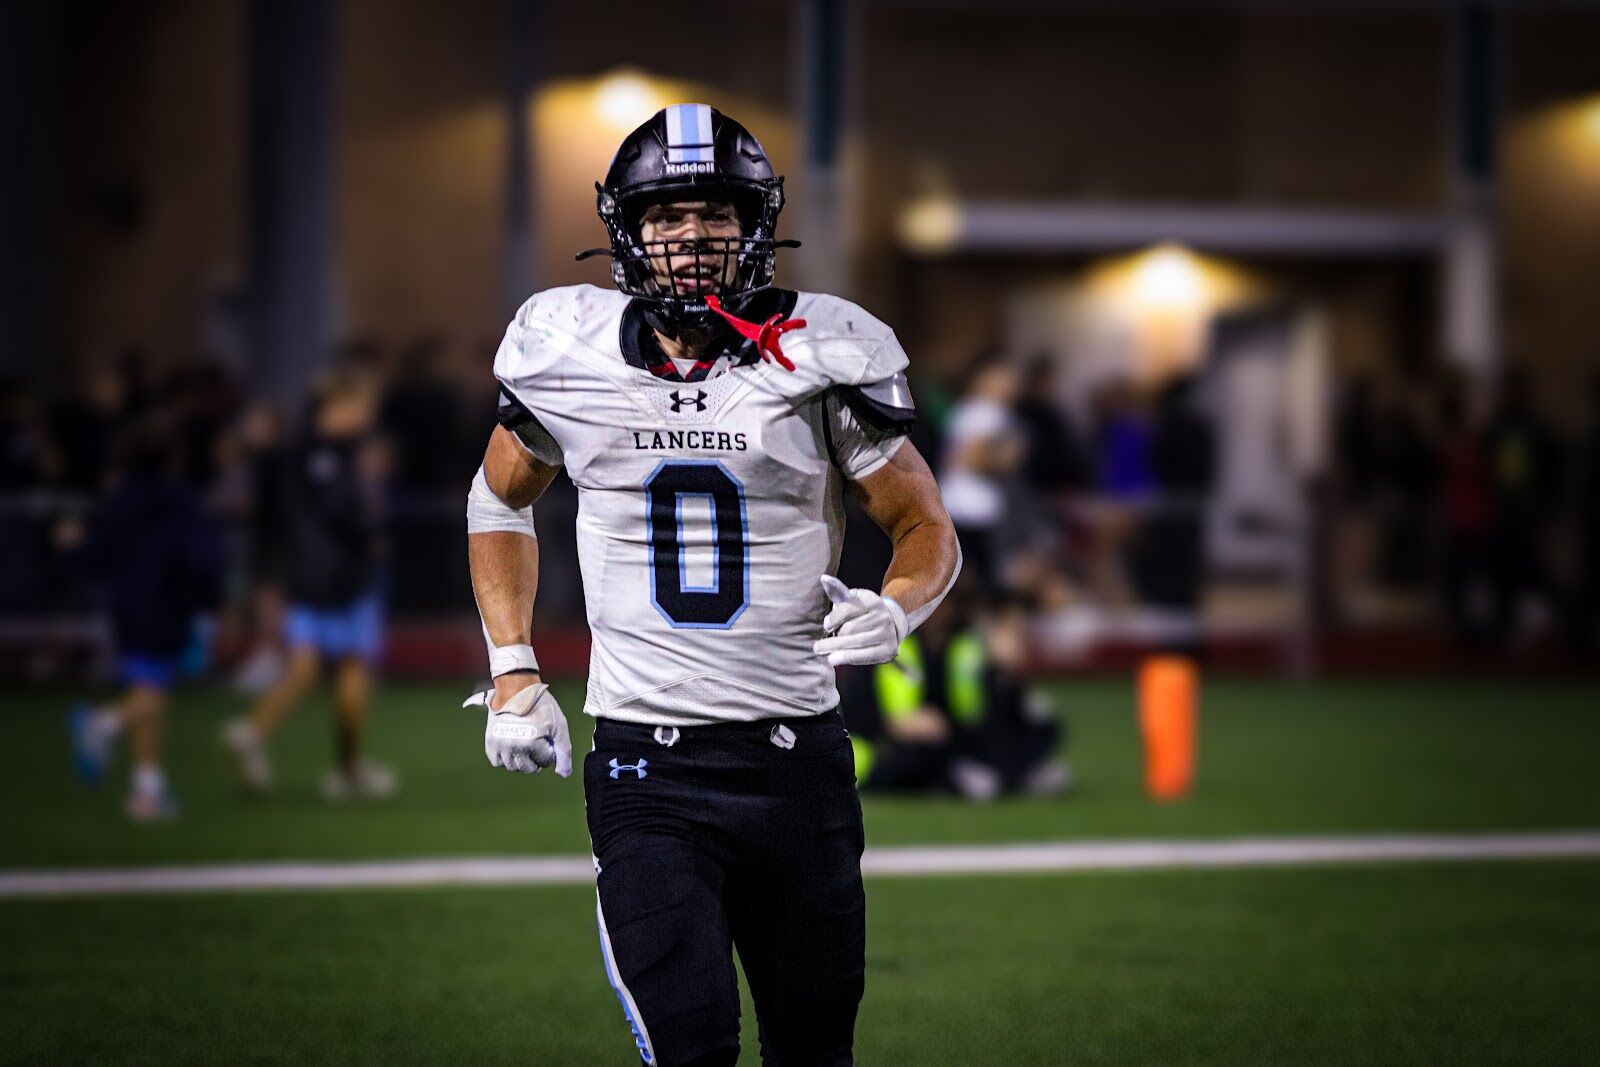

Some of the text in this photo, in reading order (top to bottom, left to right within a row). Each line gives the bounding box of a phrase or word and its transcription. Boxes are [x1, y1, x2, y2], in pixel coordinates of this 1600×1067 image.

[666, 162, 715, 174] Riddell
[633, 431, 747, 451] LANCERS
[643, 459, 750, 629] 0
